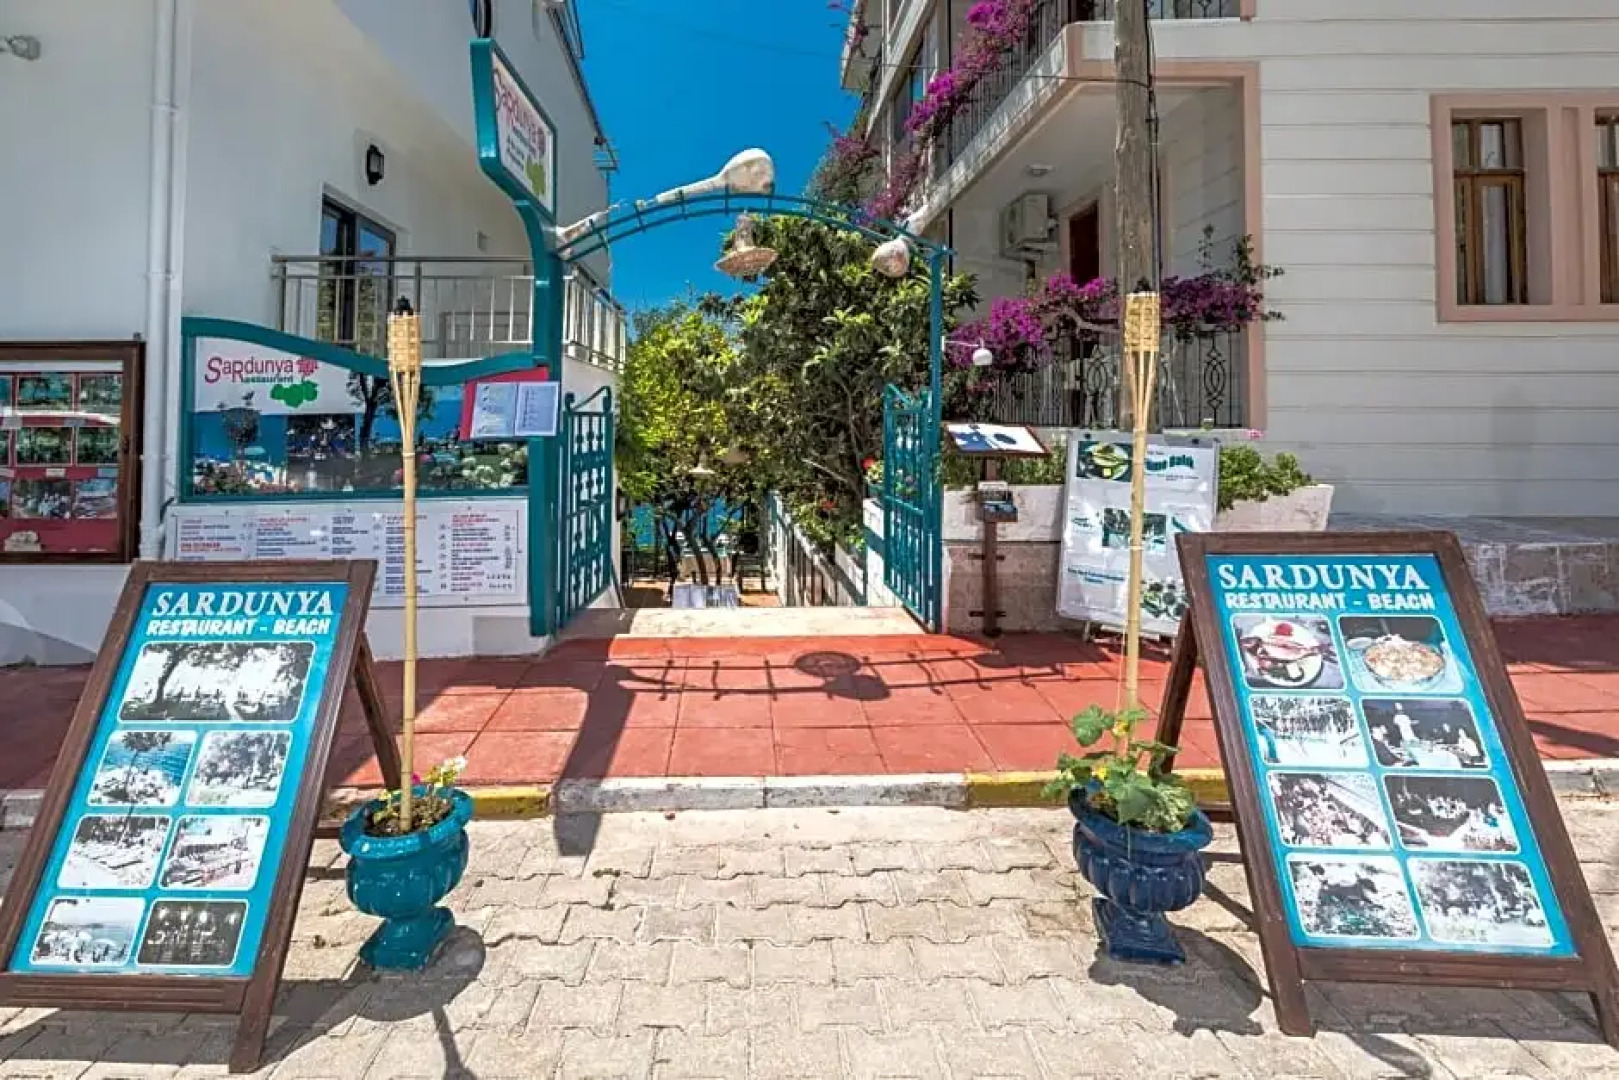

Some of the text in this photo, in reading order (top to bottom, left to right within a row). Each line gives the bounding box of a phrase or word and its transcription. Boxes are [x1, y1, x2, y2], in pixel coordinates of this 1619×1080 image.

[1218, 564, 1430, 590] SARDUNYA
[152, 591, 333, 616] SARDUNYA
[1225, 592, 1346, 610] RESTAURANT
[1368, 593, 1435, 610] BEACH
[146, 618, 257, 636] RESTAURANT
[273, 618, 330, 635] BEACH
